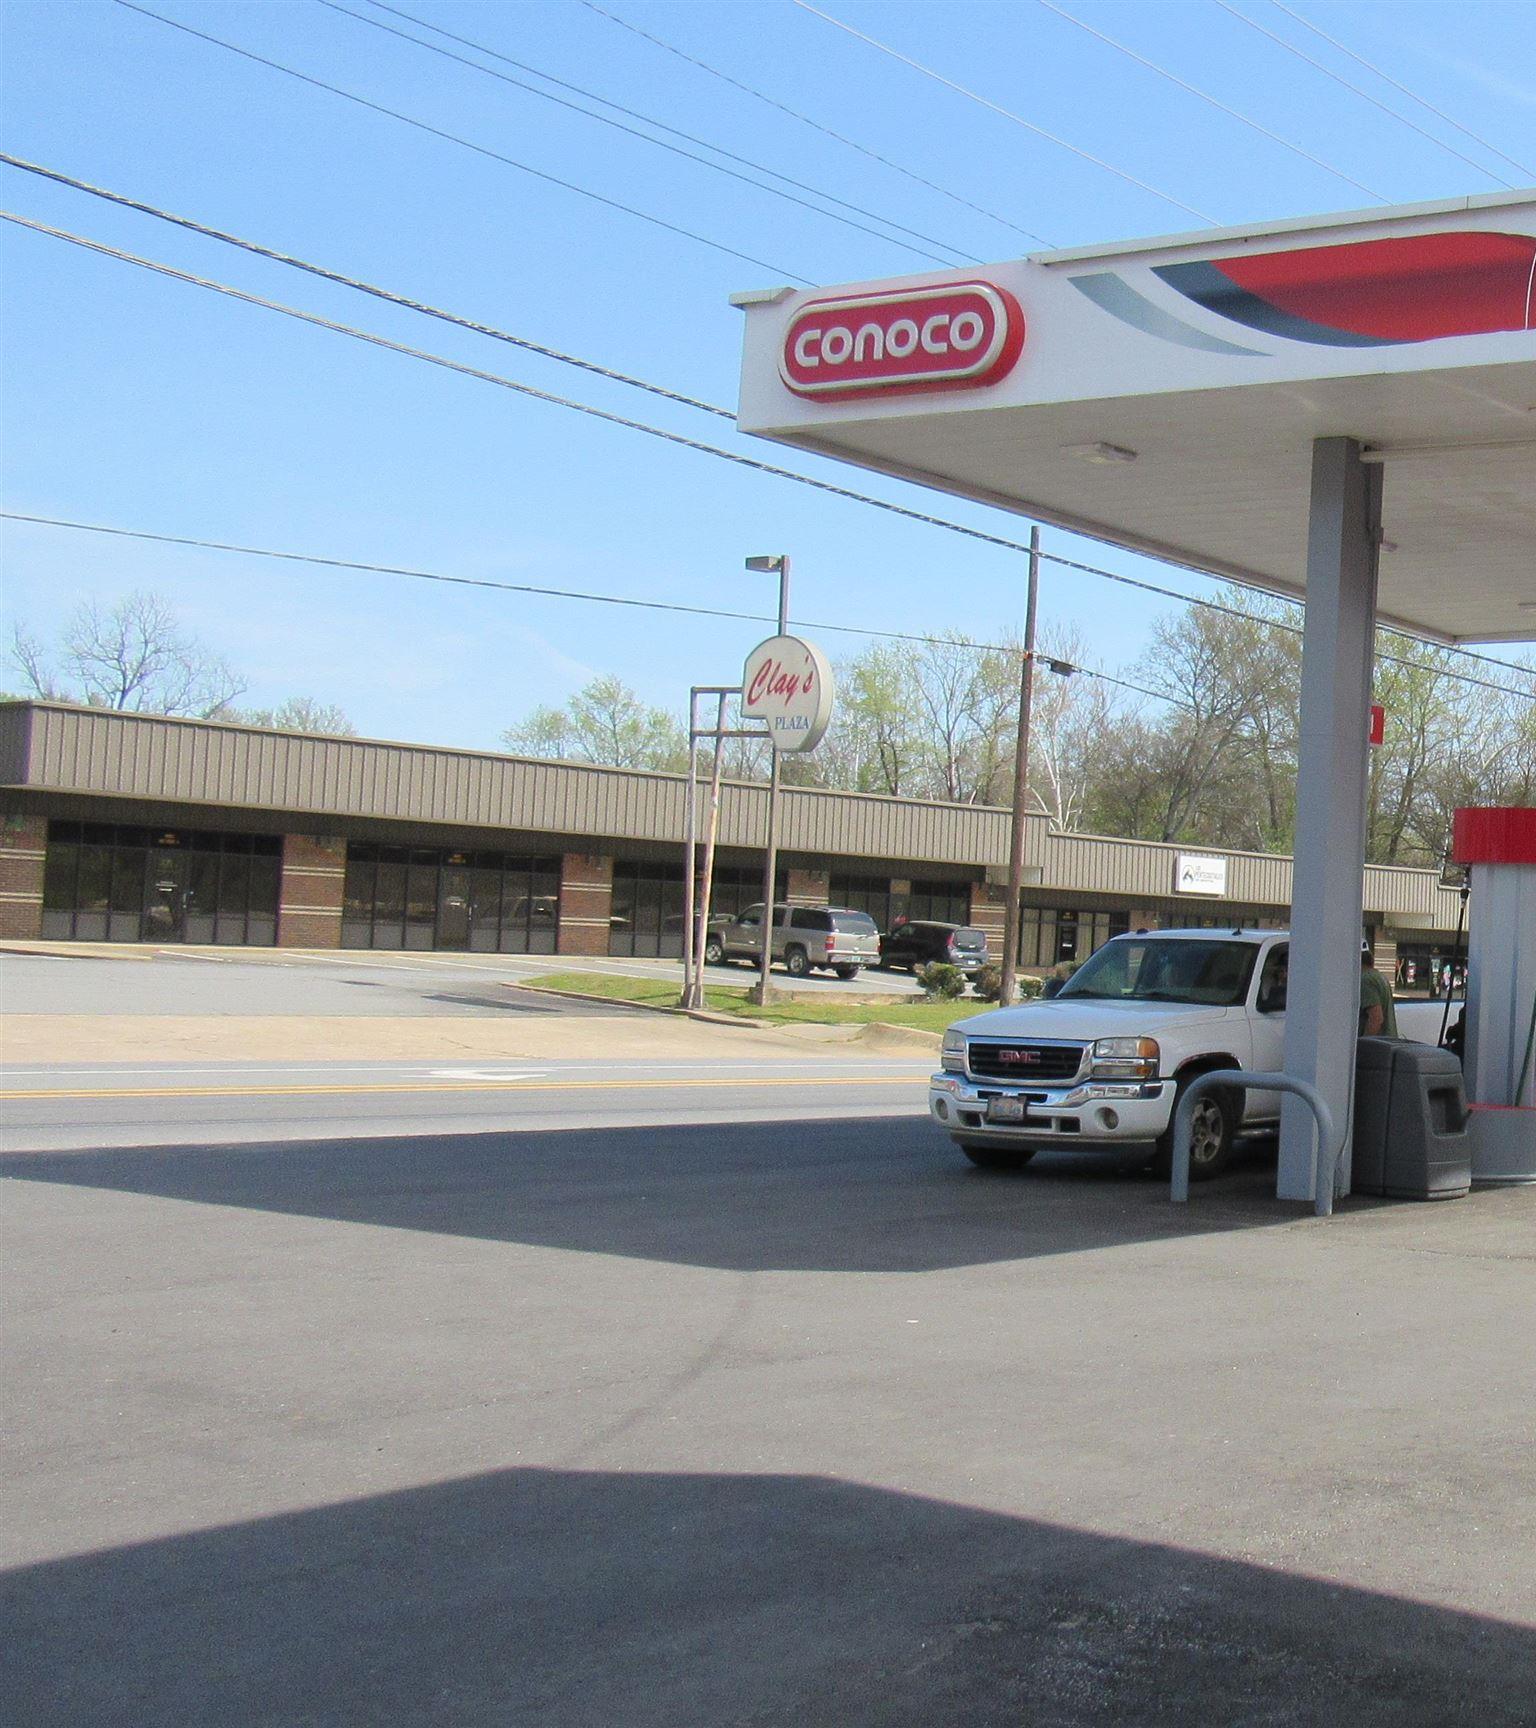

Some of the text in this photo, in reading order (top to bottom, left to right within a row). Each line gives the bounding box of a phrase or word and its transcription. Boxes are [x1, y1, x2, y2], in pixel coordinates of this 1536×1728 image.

[747, 655, 813, 706] Clay's
[775, 716, 809, 730] PLAZA
[1000, 1050, 1041, 1064] GMC
